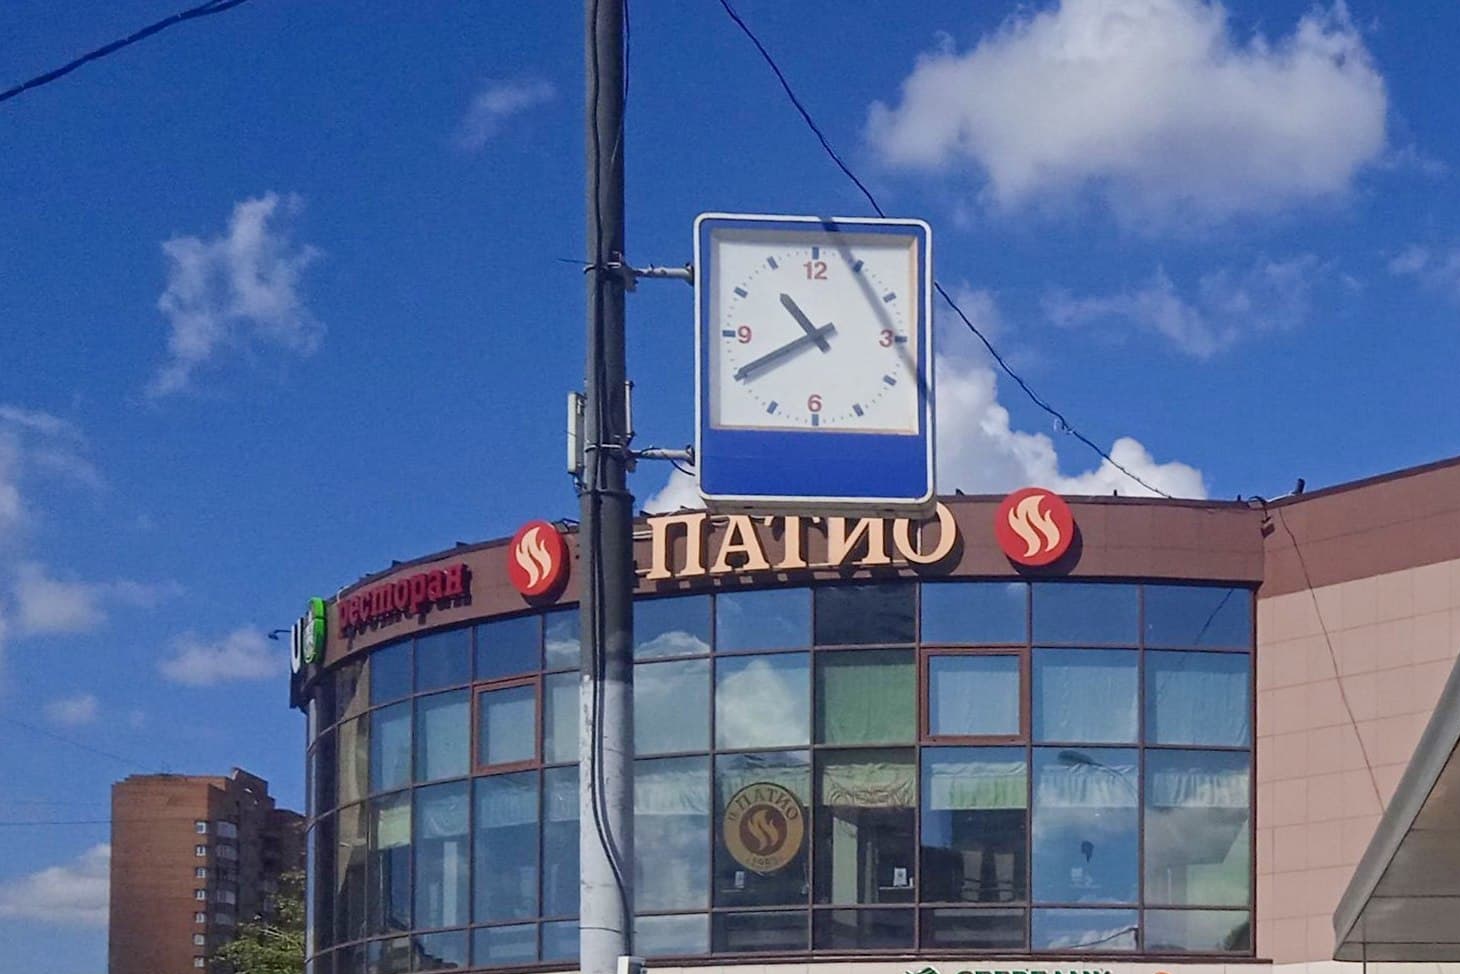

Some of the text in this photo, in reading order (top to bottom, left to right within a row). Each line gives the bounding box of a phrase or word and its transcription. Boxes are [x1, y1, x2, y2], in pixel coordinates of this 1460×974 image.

[803, 261, 828, 280] 12
[737, 325, 894, 347] 9 3
[807, 394, 822, 412] 6
[647, 501, 957, 580] ПАТИО
[337, 563, 465, 628] ресторан
